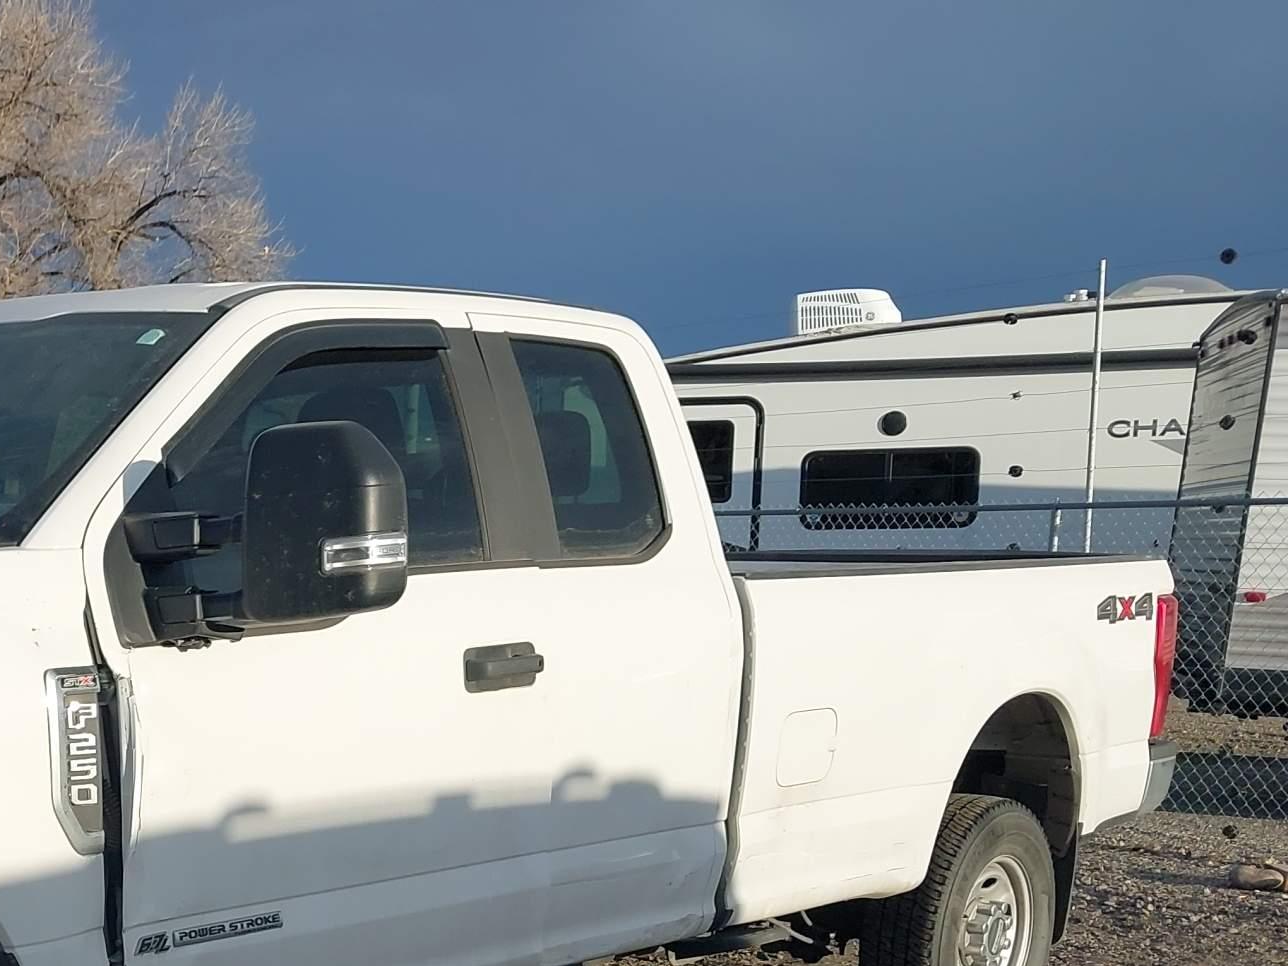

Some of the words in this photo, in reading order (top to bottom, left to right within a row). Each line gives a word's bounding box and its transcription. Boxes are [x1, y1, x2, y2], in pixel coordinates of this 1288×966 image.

[1107, 418, 1186, 438] CHA
[178, 924, 226, 941] POWER
[229, 913, 281, 932] STROKE
